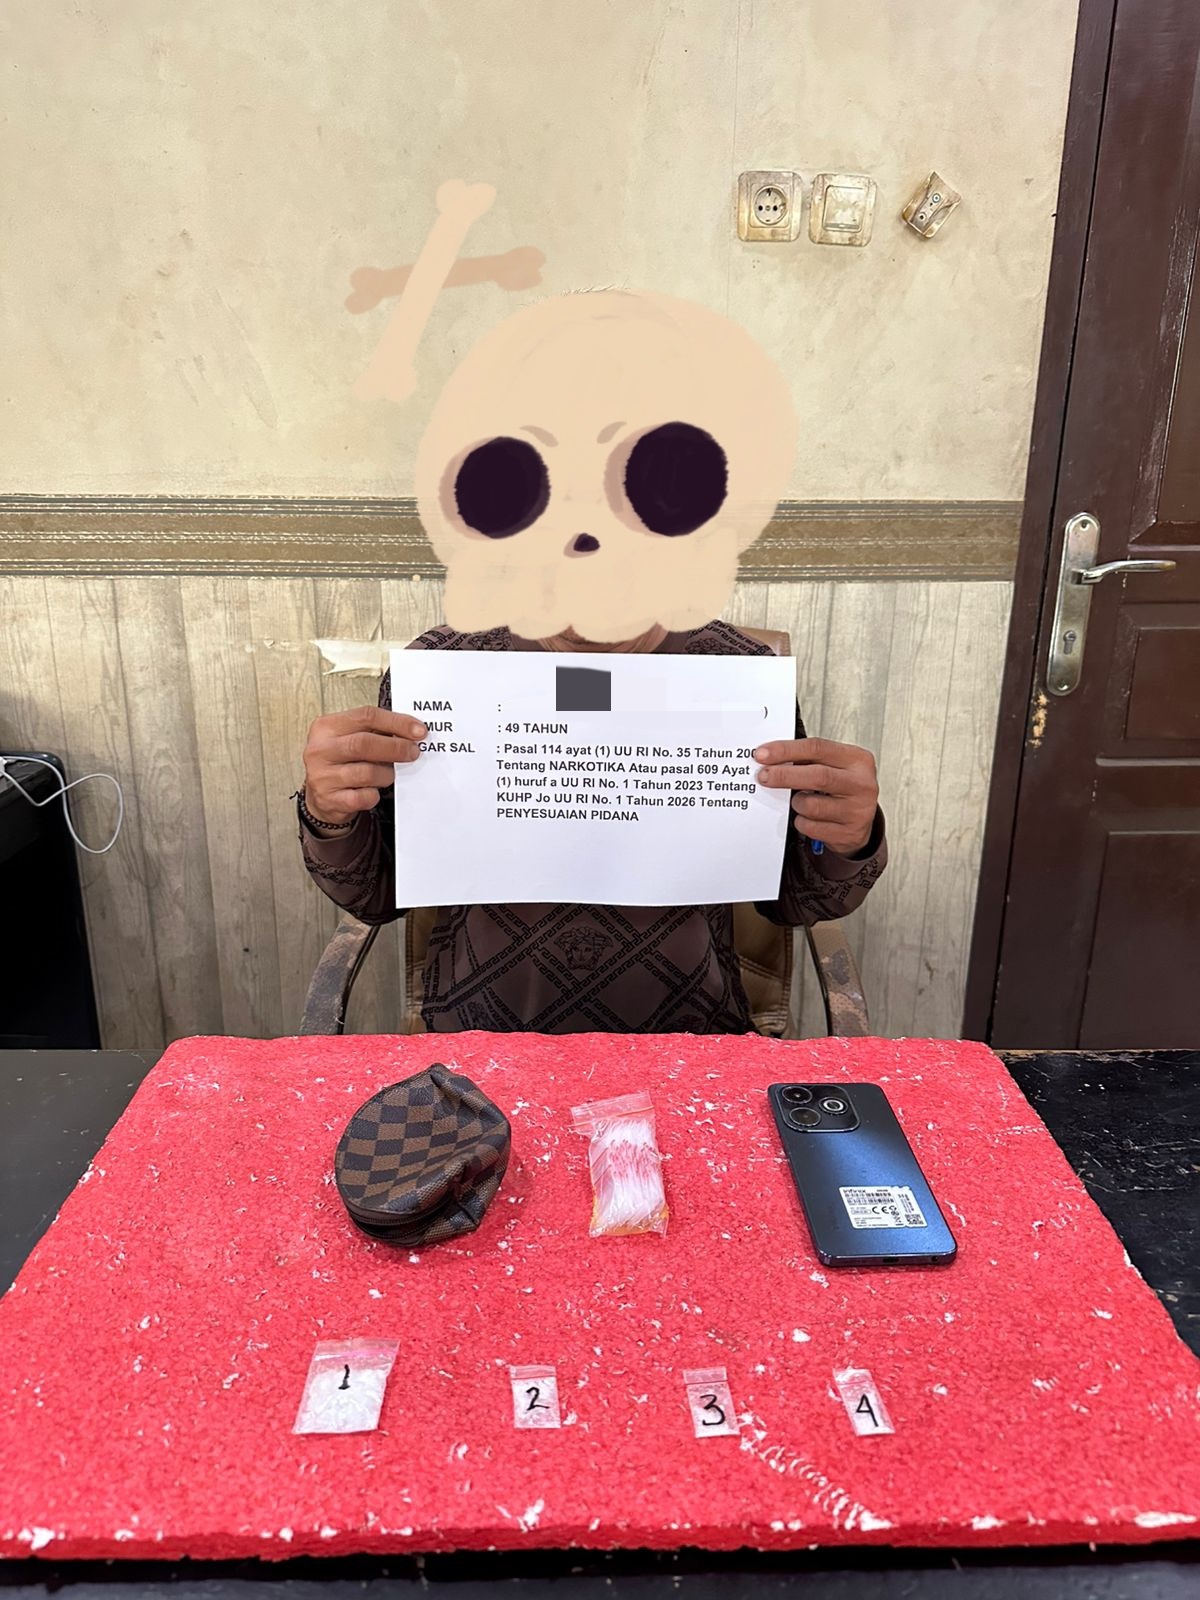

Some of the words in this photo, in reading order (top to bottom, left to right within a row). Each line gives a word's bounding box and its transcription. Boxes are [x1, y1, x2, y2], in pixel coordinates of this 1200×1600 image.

[413, 700, 453, 711] NAMA
[424, 721, 453, 732] MUR
[505, 722, 520, 733] 49
[523, 722, 568, 734] TAHUN
[449, 742, 476, 753] SAL
[504, 743, 537, 754] Pasal
[541, 744, 563, 755] 114
[565, 745, 592, 758] ayat
[594, 745, 611, 758] (1)
[614, 745, 632, 757] UU
[636, 746, 649, 757] RI
[652, 746, 673, 758] No.
[676, 747, 691, 758] 35
[694, 747, 733, 759] Tahun
[496, 759, 546, 773] Tentang
[549, 760, 626, 773] NARKOTIKA
[628, 762, 658, 774] Atau
[660, 764, 694, 777] pasal
[697, 764, 719, 775] 609
[721, 764, 750, 778] Ayat
[496, 776, 511, 788] (1)
[514, 776, 548, 787] huruf
[550, 779, 557, 787] a
[561, 777, 579, 788] UU
[582, 777, 595, 788] RI
[598, 778, 619, 789] No.
[623, 778, 629, 789] 1
[632, 779, 671, 790] Tahun
[674, 780, 703, 791] 2023
[706, 780, 756, 794] Tentang
[496, 791, 533, 803] KUHP
[535, 792, 551, 803] Jo
[554, 793, 572, 804] UU
[575, 793, 589, 804] RI
[591, 794, 612, 805] No.
[616, 794, 622, 805] 1
[625, 795, 664, 807] Tahun
[667, 796, 696, 807] 2026
[699, 796, 749, 811] Tentang
[496, 807, 587, 820] PENYESUAIAN
[590, 809, 639, 822] PIDANA
[338, 1364, 350, 1390] 1
[526, 1386, 550, 1411] 2
[700, 1394, 726, 1426] 3
[856, 1393, 879, 1427] 4
